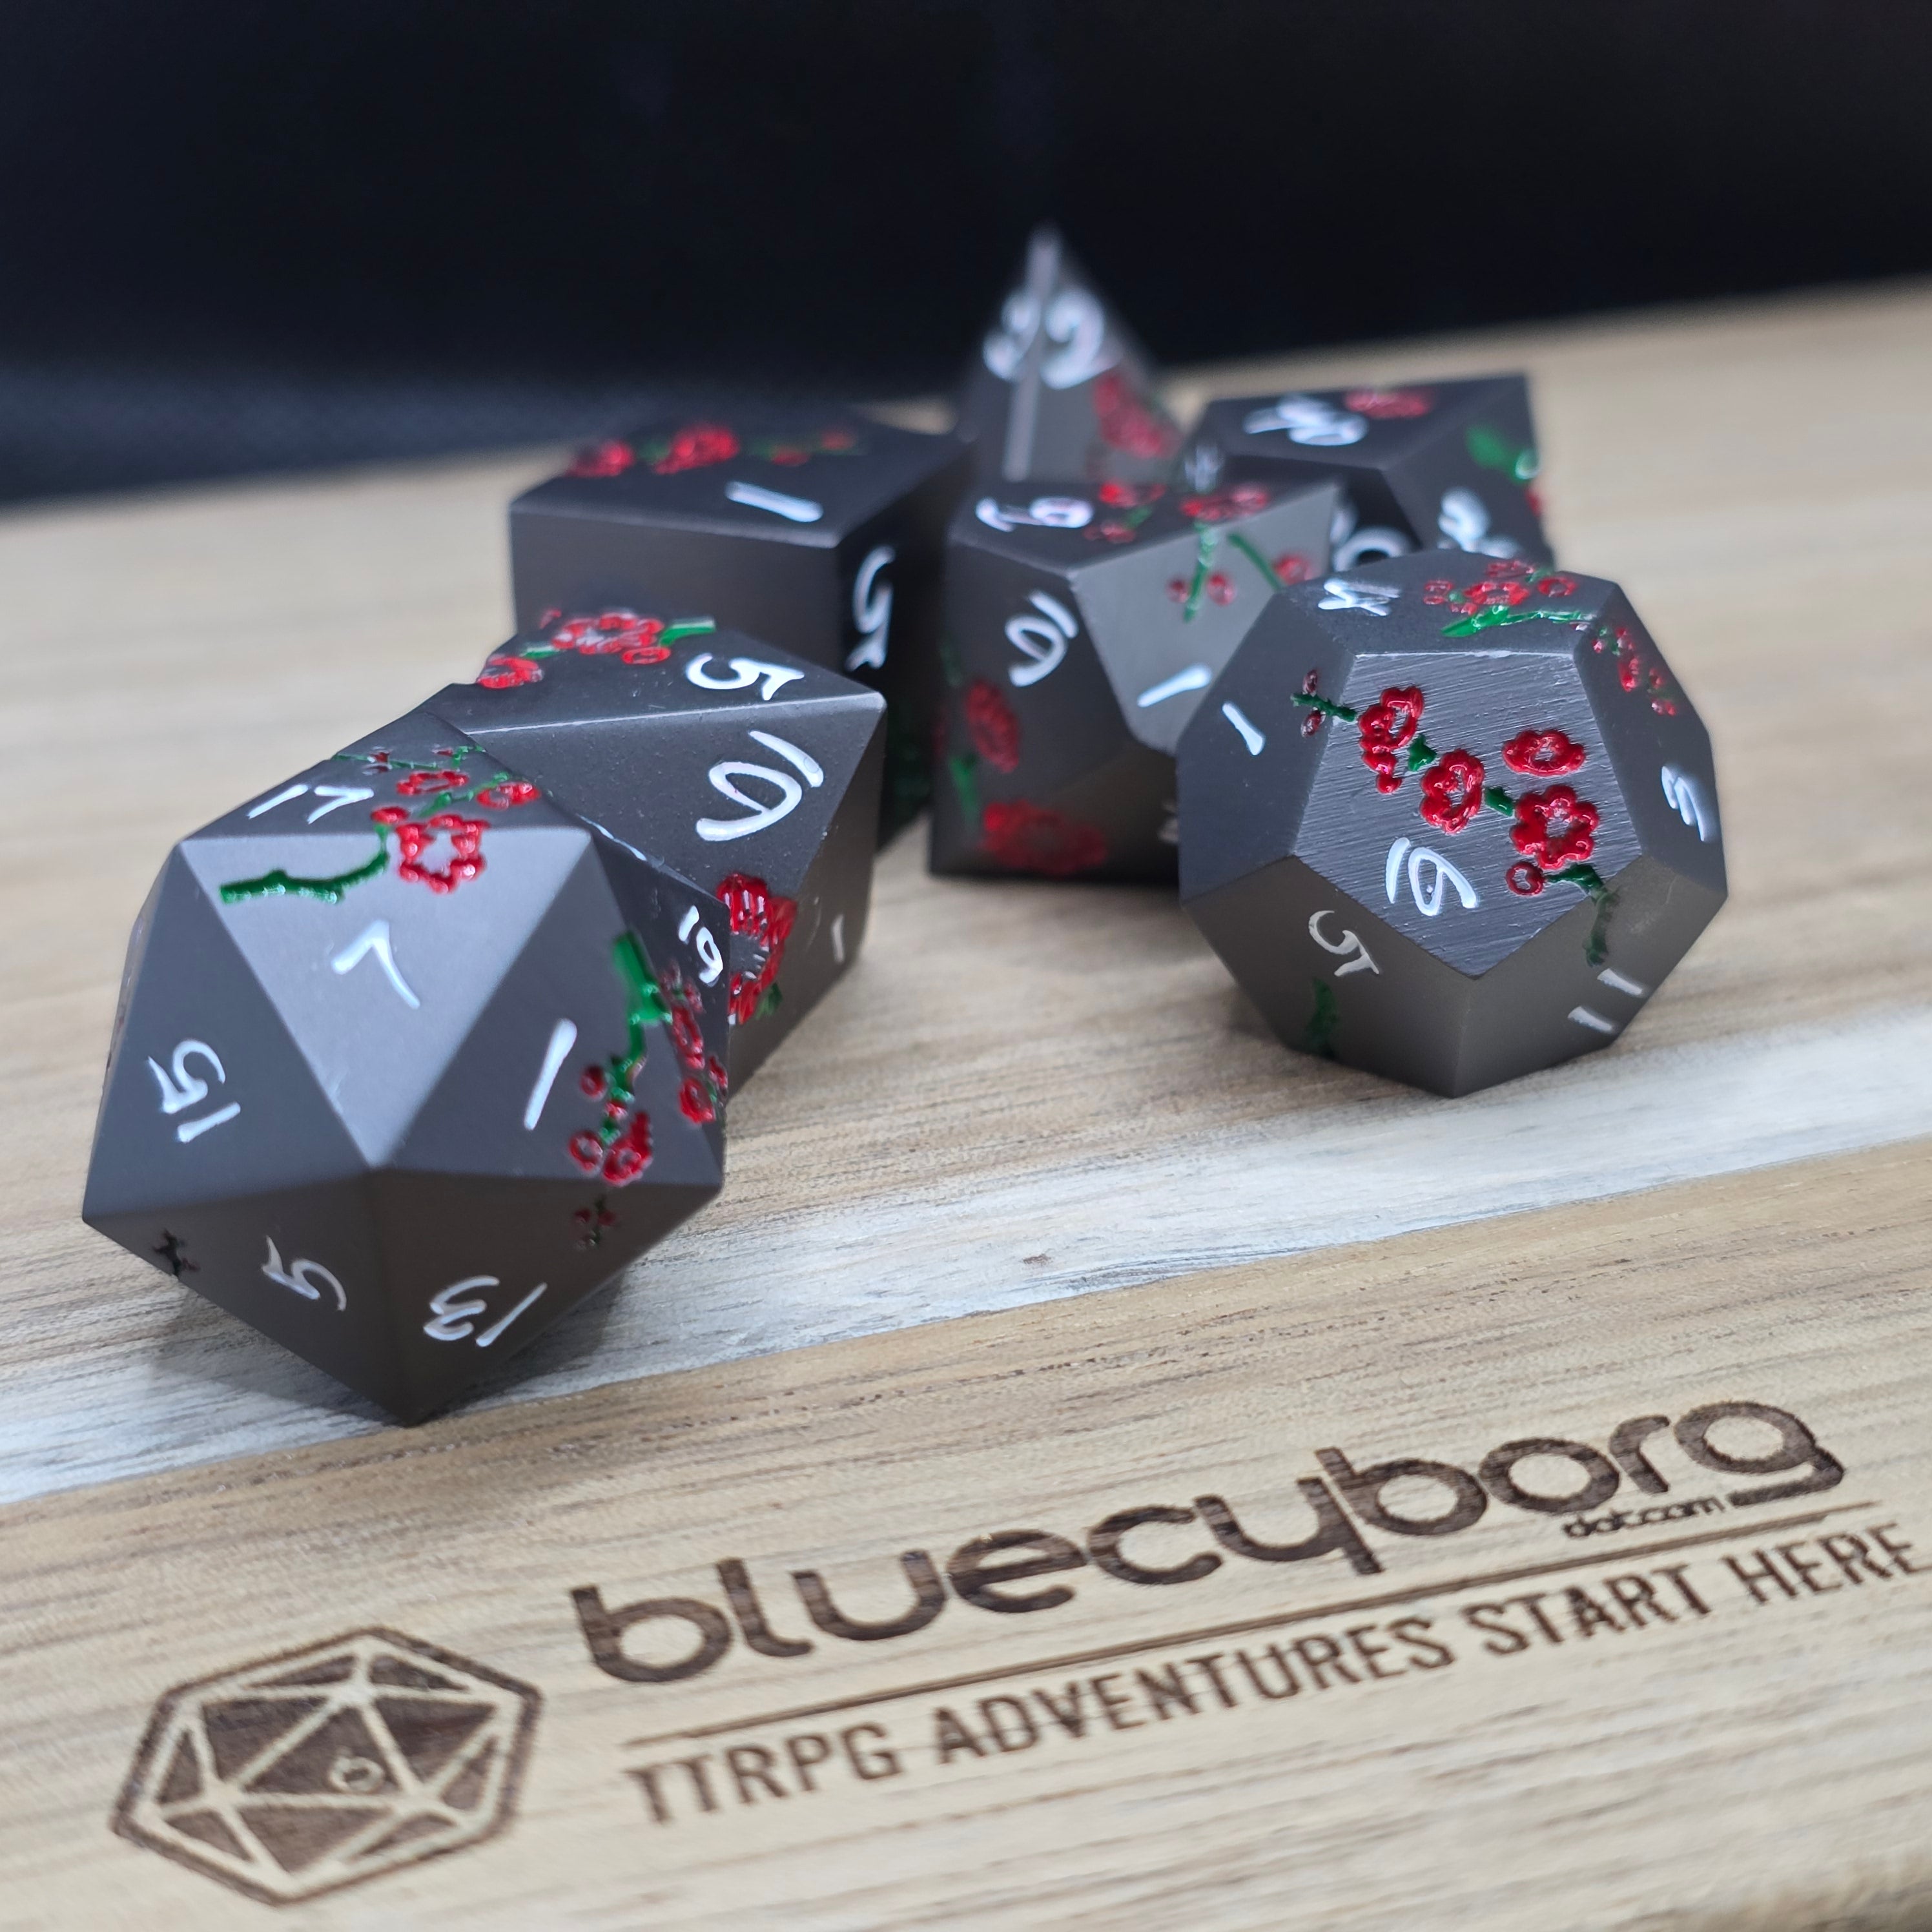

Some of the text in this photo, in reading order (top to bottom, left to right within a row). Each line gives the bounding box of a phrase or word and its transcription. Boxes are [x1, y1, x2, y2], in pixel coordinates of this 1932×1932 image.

[686, 653, 805, 701] 5
[247, 783, 375, 825] 17
[331, 920, 420, 1009] 7
[1308, 909, 1381, 978] 5
[148, 1039, 242, 1144] 15
[524, 1019, 578, 1131] 1
[261, 1235, 347, 1312] 5
[423, 1275, 548, 1348] 13
[569, 1399, 1845, 1683] bluecyborg
[624, 1522, 1932, 1825] TTRPG ADVENTURES START HERE
